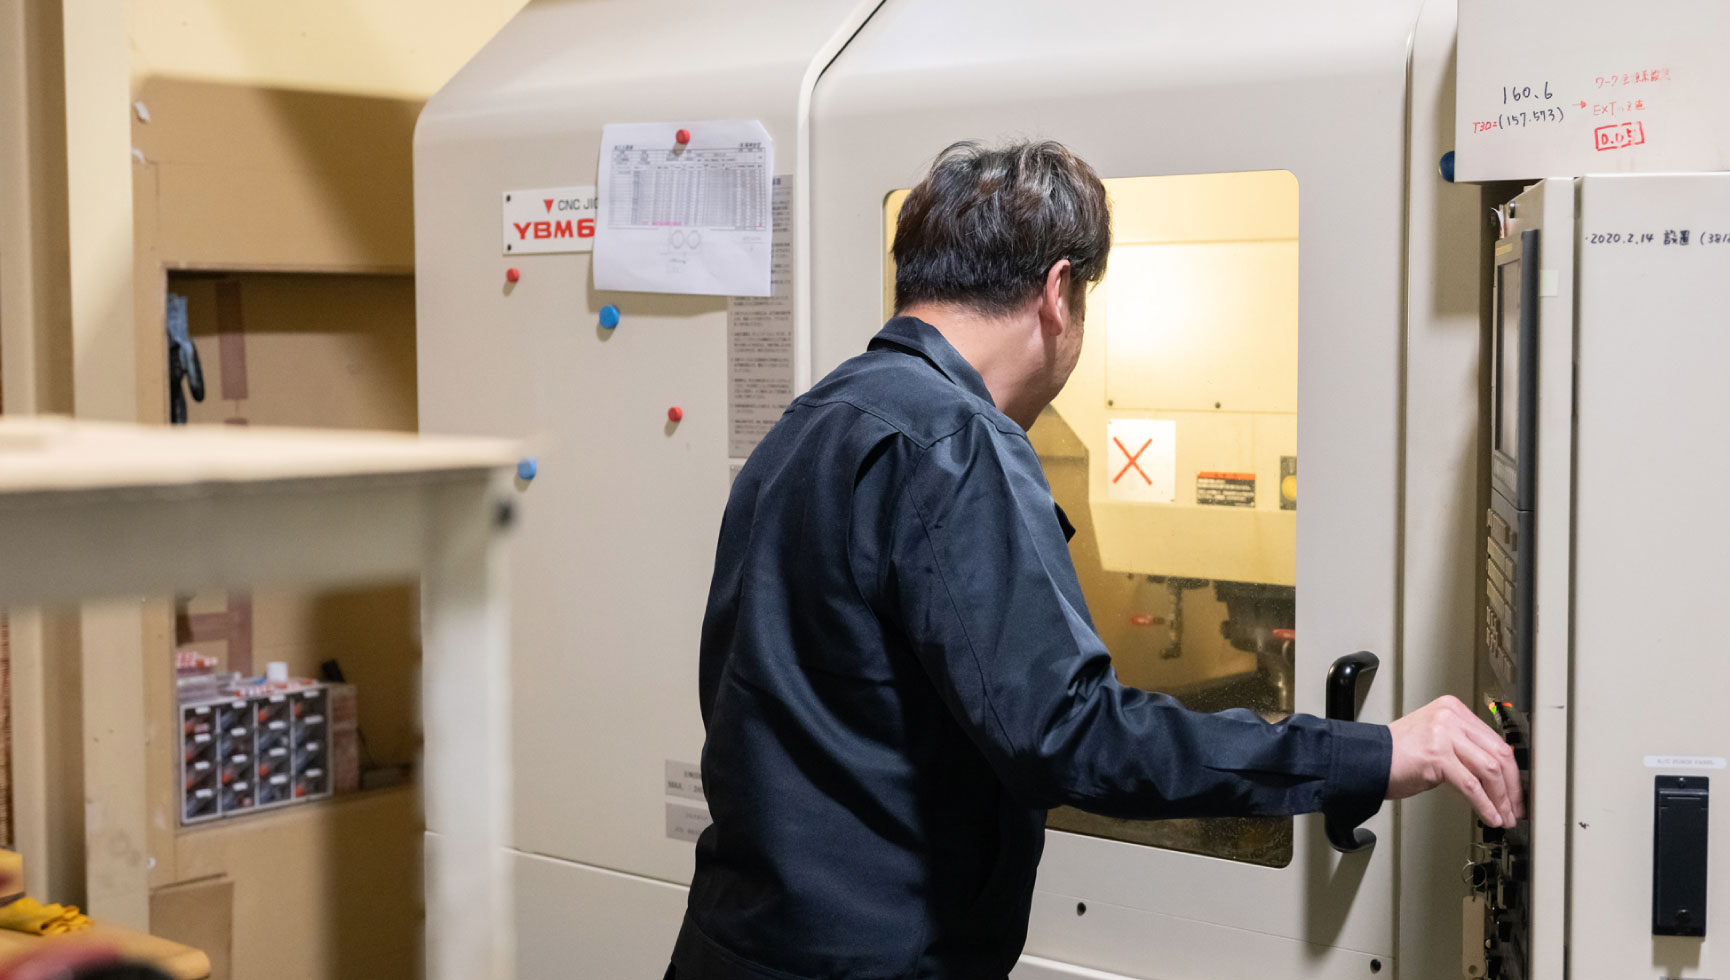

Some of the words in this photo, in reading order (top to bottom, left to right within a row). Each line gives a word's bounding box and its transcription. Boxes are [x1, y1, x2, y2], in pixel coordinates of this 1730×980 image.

[1498, 106, 1564, 130] (157.573)
[557, 199, 581, 211] CNC
[512, 217, 595, 240] YBM6
